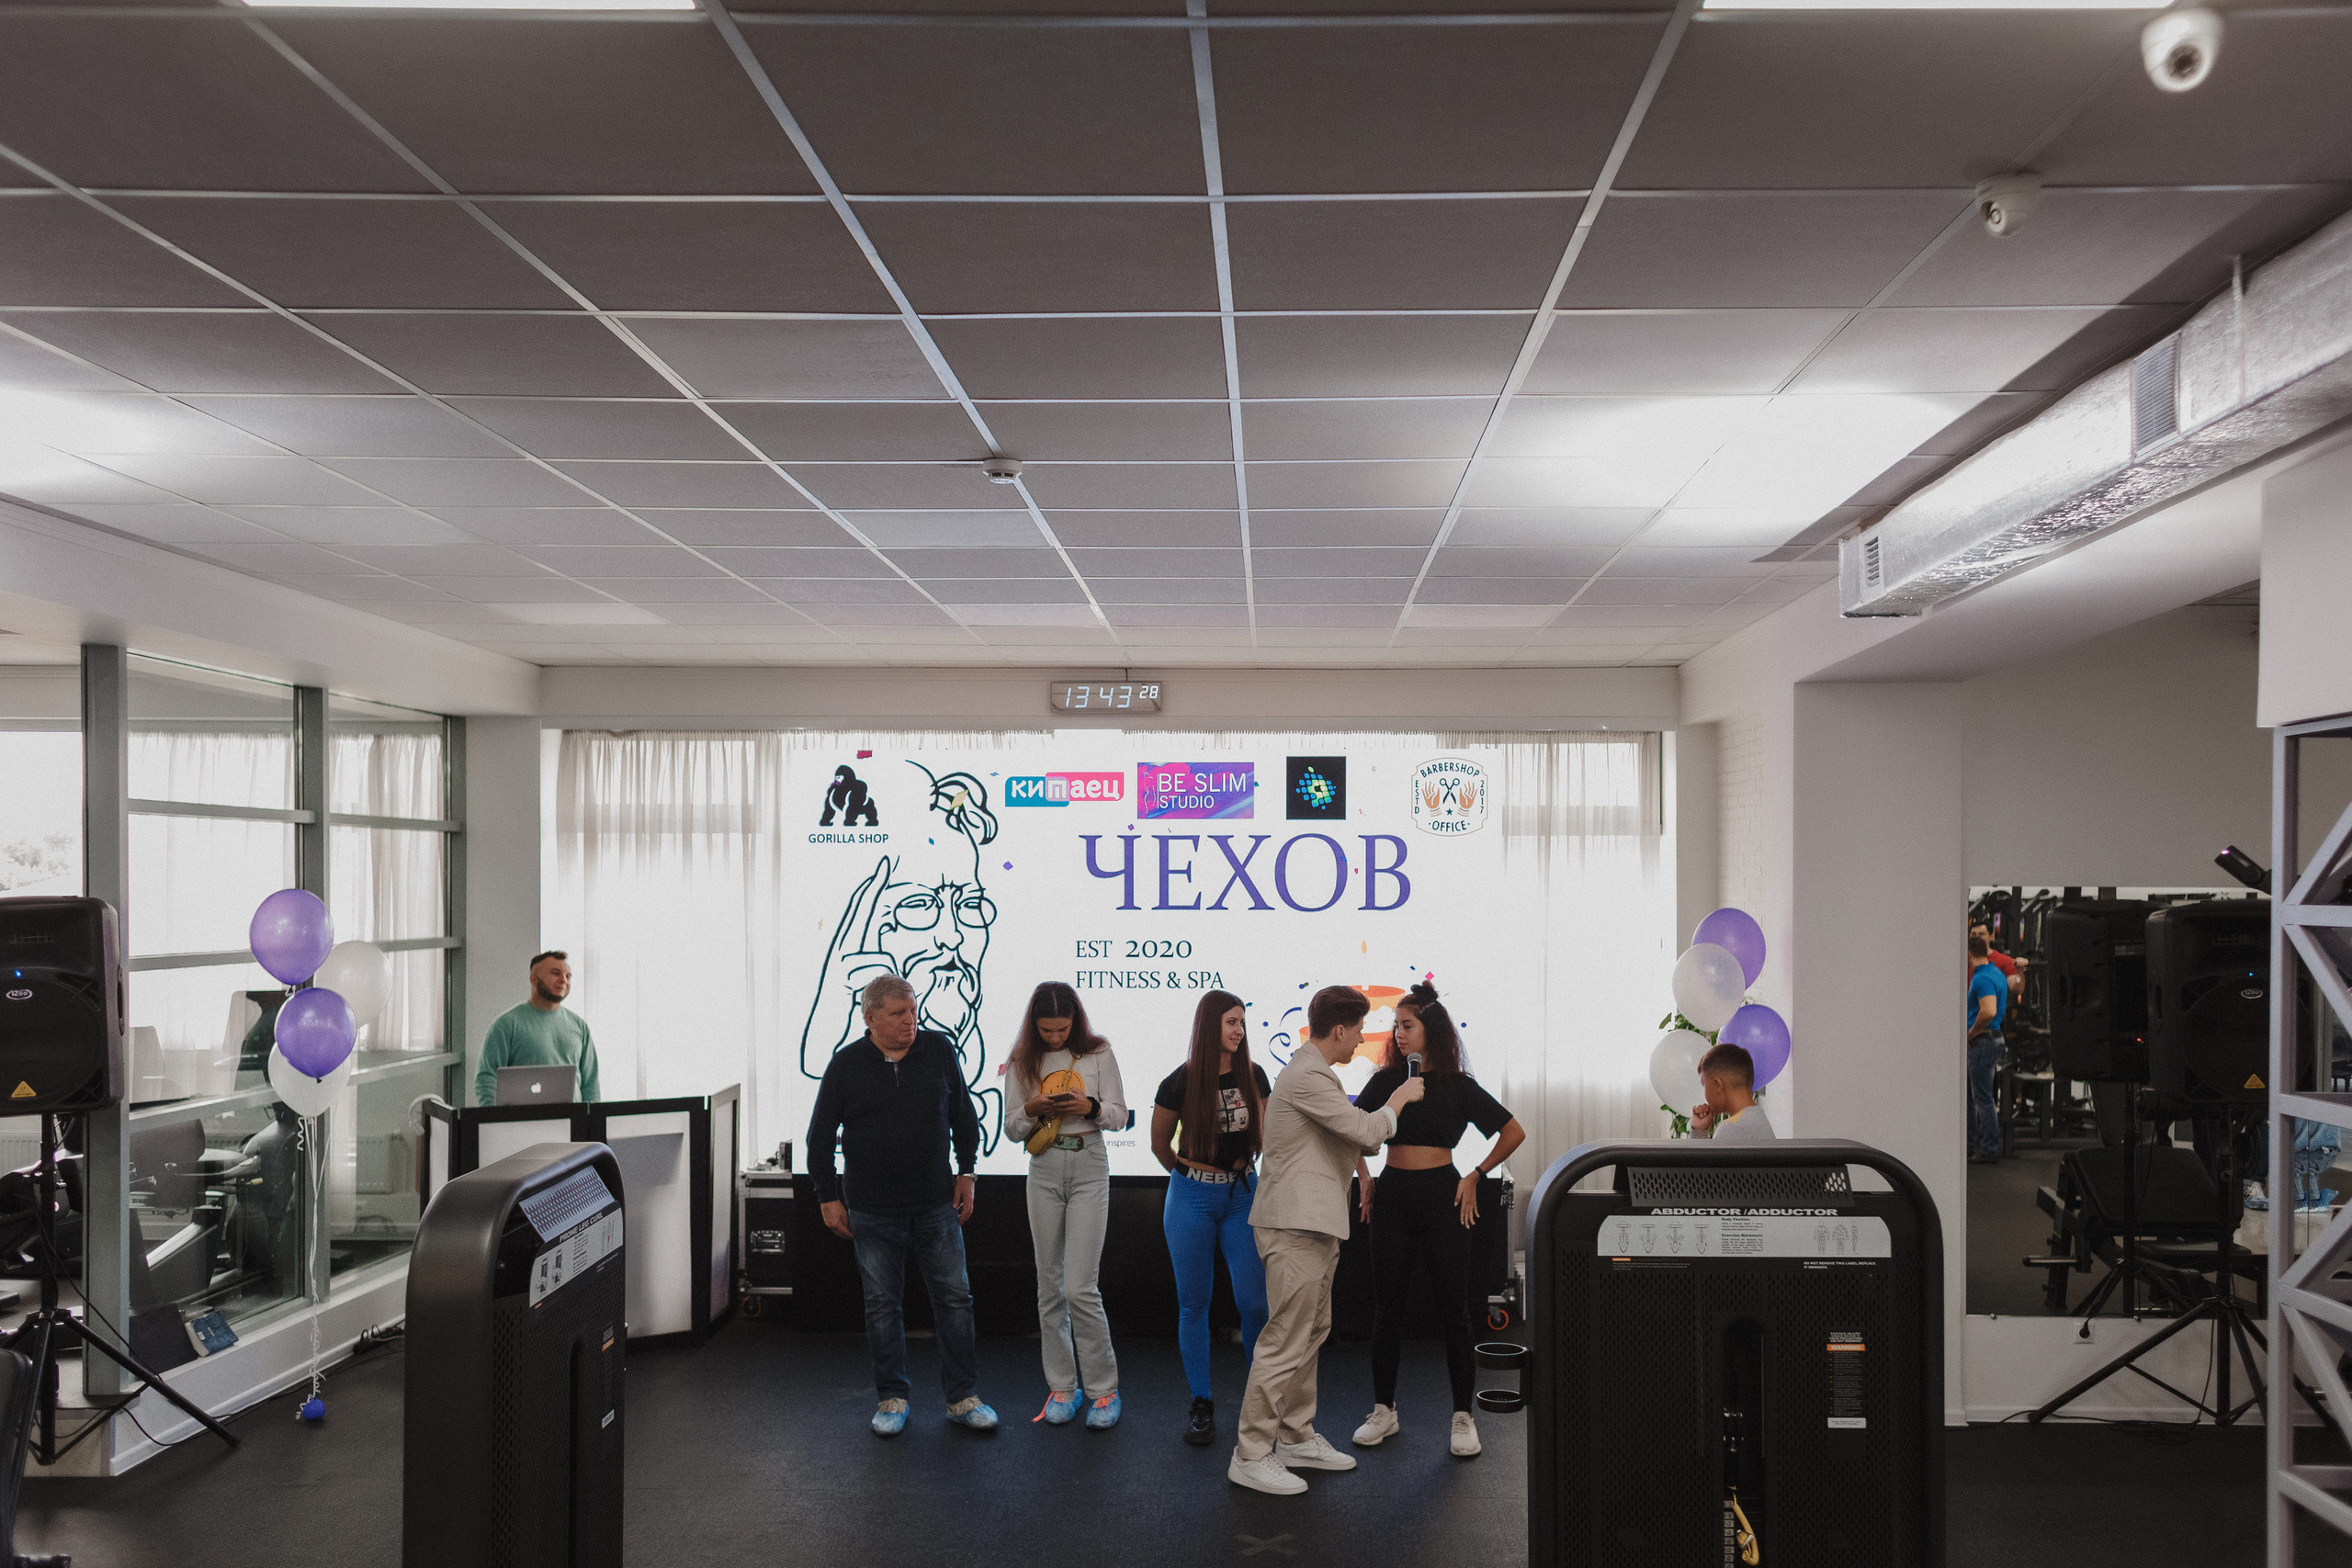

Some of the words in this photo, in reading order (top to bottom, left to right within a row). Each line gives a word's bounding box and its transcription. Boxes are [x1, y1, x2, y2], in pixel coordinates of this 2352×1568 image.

[1066, 685, 1090, 708] 13
[1100, 685, 1132, 708] 43
[1139, 685, 1159, 699] 28
[1419, 762, 1480, 778] BARBERSHOP
[1011, 779, 1120, 800] китаец
[1159, 773, 1186, 793] BE
[1194, 773, 1246, 793] SLIM
[1159, 795, 1215, 809] STUDIO
[808, 833, 855, 843] GORILLA
[858, 833, 888, 843] SHOP
[1079, 833, 1410, 912] ЧЕХОВ
[1076, 940, 1113, 958] EST
[1125, 940, 1193, 959] 2020
[1076, 971, 1160, 989] FITNESS
[1166, 971, 1182, 989] &
[1187, 971, 1225, 989] SPA
[1107, 1139, 1136, 1148] inspires
[1651, 1208, 1741, 1216] ABDUCTOR
[579, 1219, 590, 1231] LEG
[590, 1212, 603, 1224] CURL
